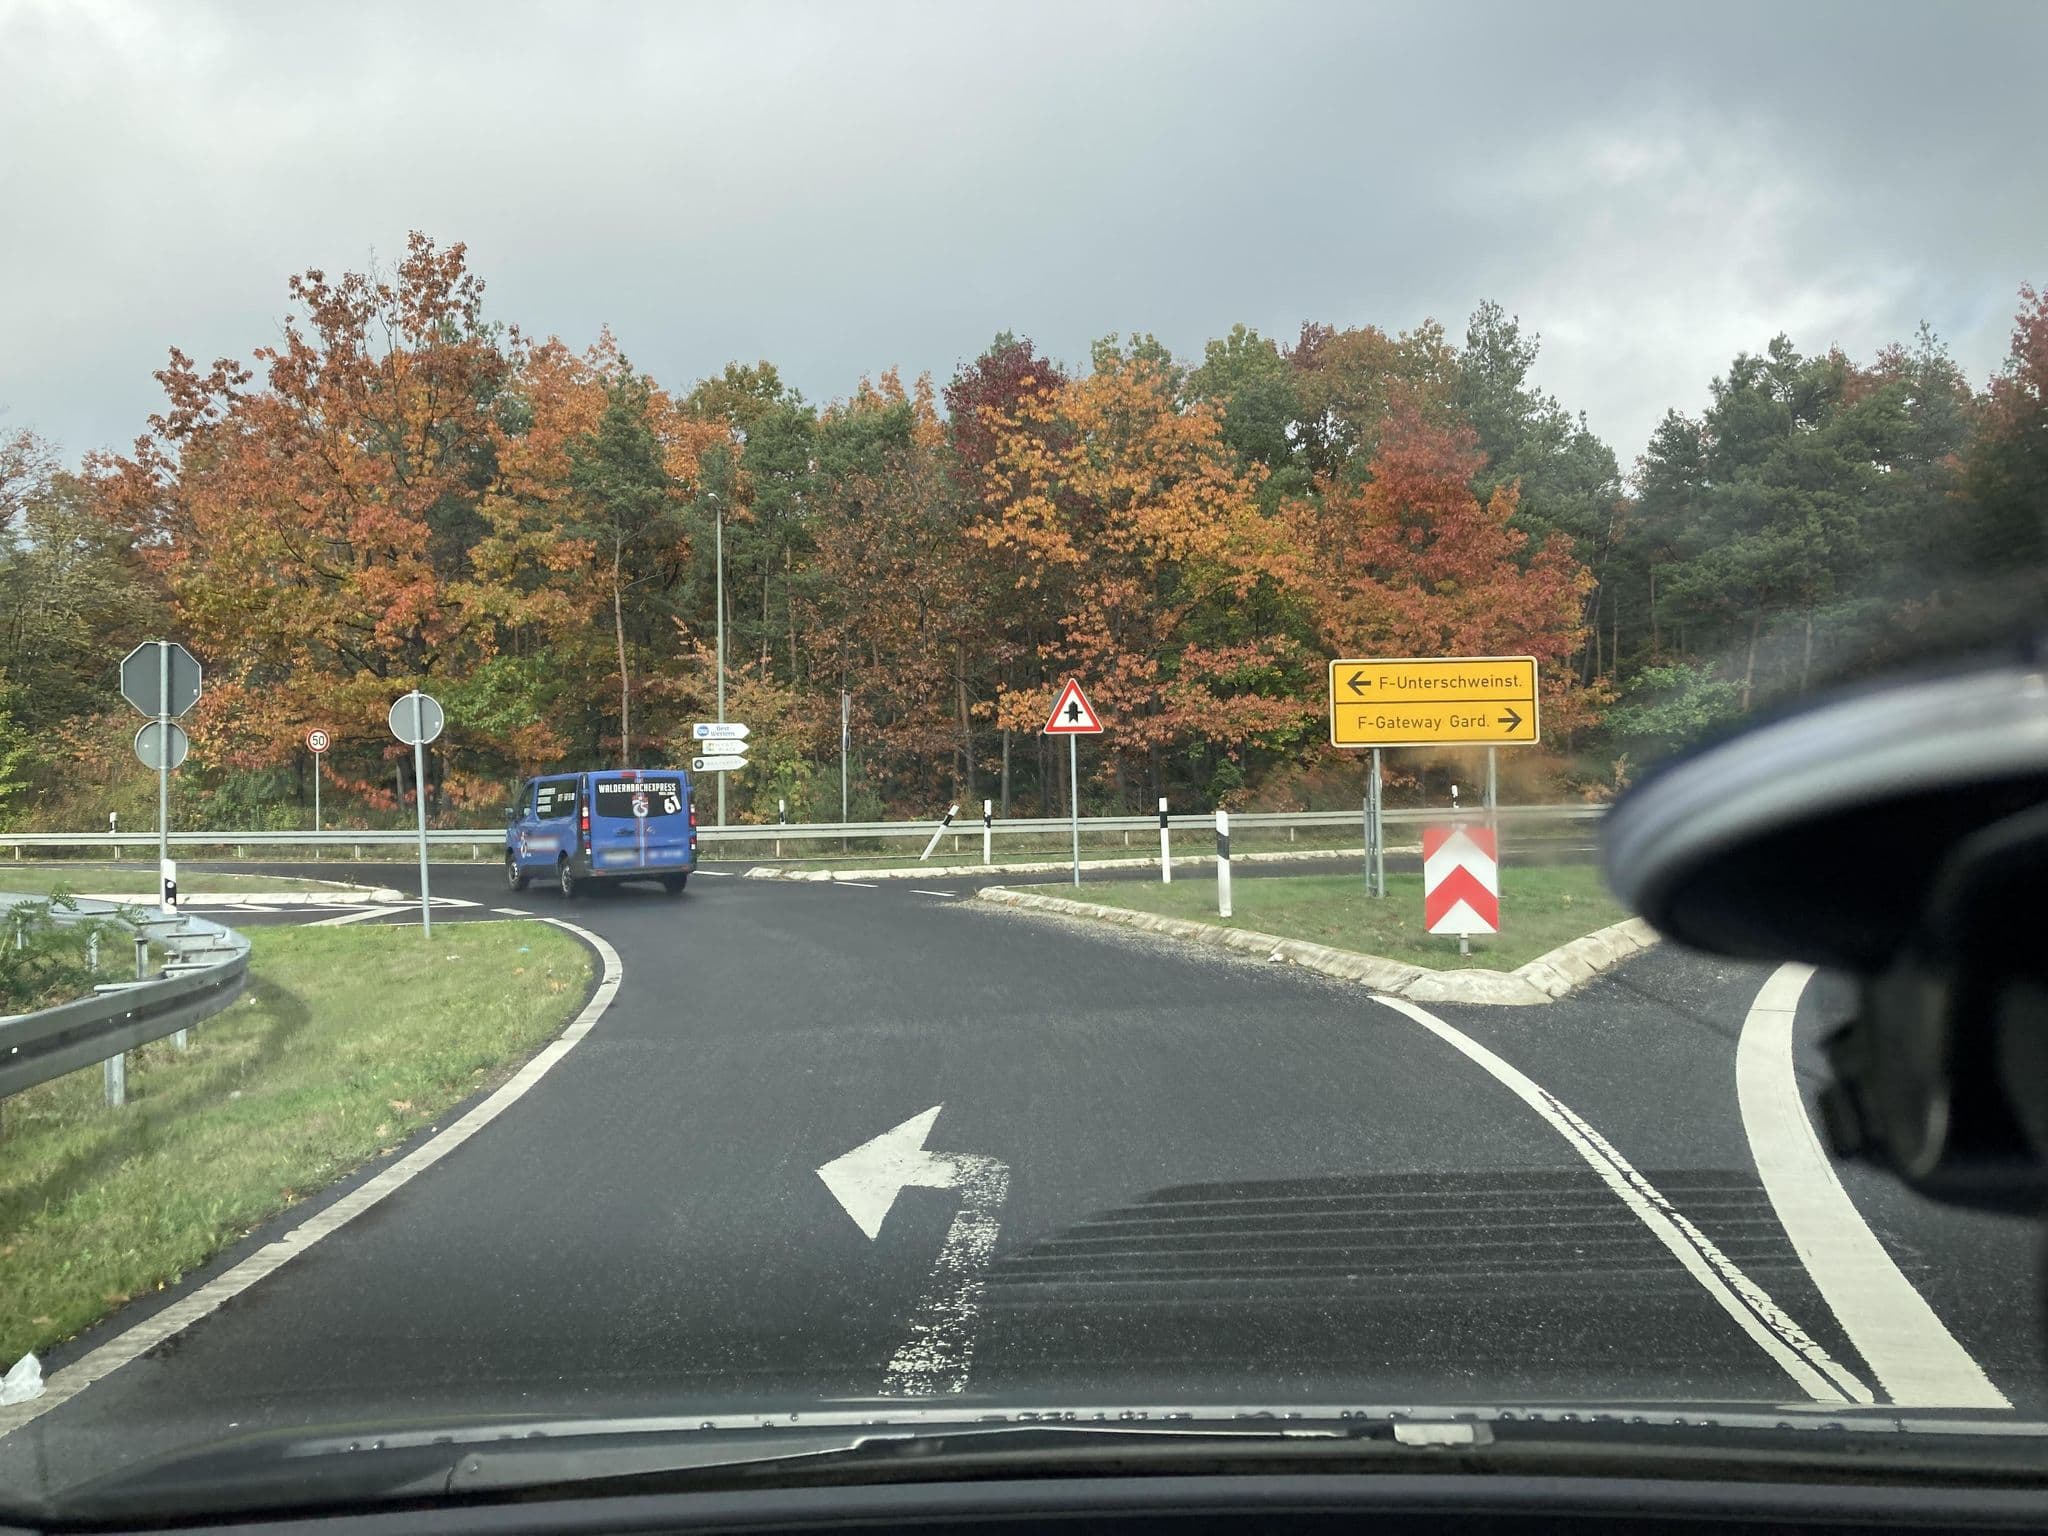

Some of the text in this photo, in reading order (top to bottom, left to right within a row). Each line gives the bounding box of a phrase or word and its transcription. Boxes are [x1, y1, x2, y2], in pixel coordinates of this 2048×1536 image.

[1379, 675, 1523, 689] F-Unterschweinst.
[1357, 714, 1490, 731] F-Gateway Gard.
[312, 735, 325, 746] 50
[664, 795, 681, 814] 61
